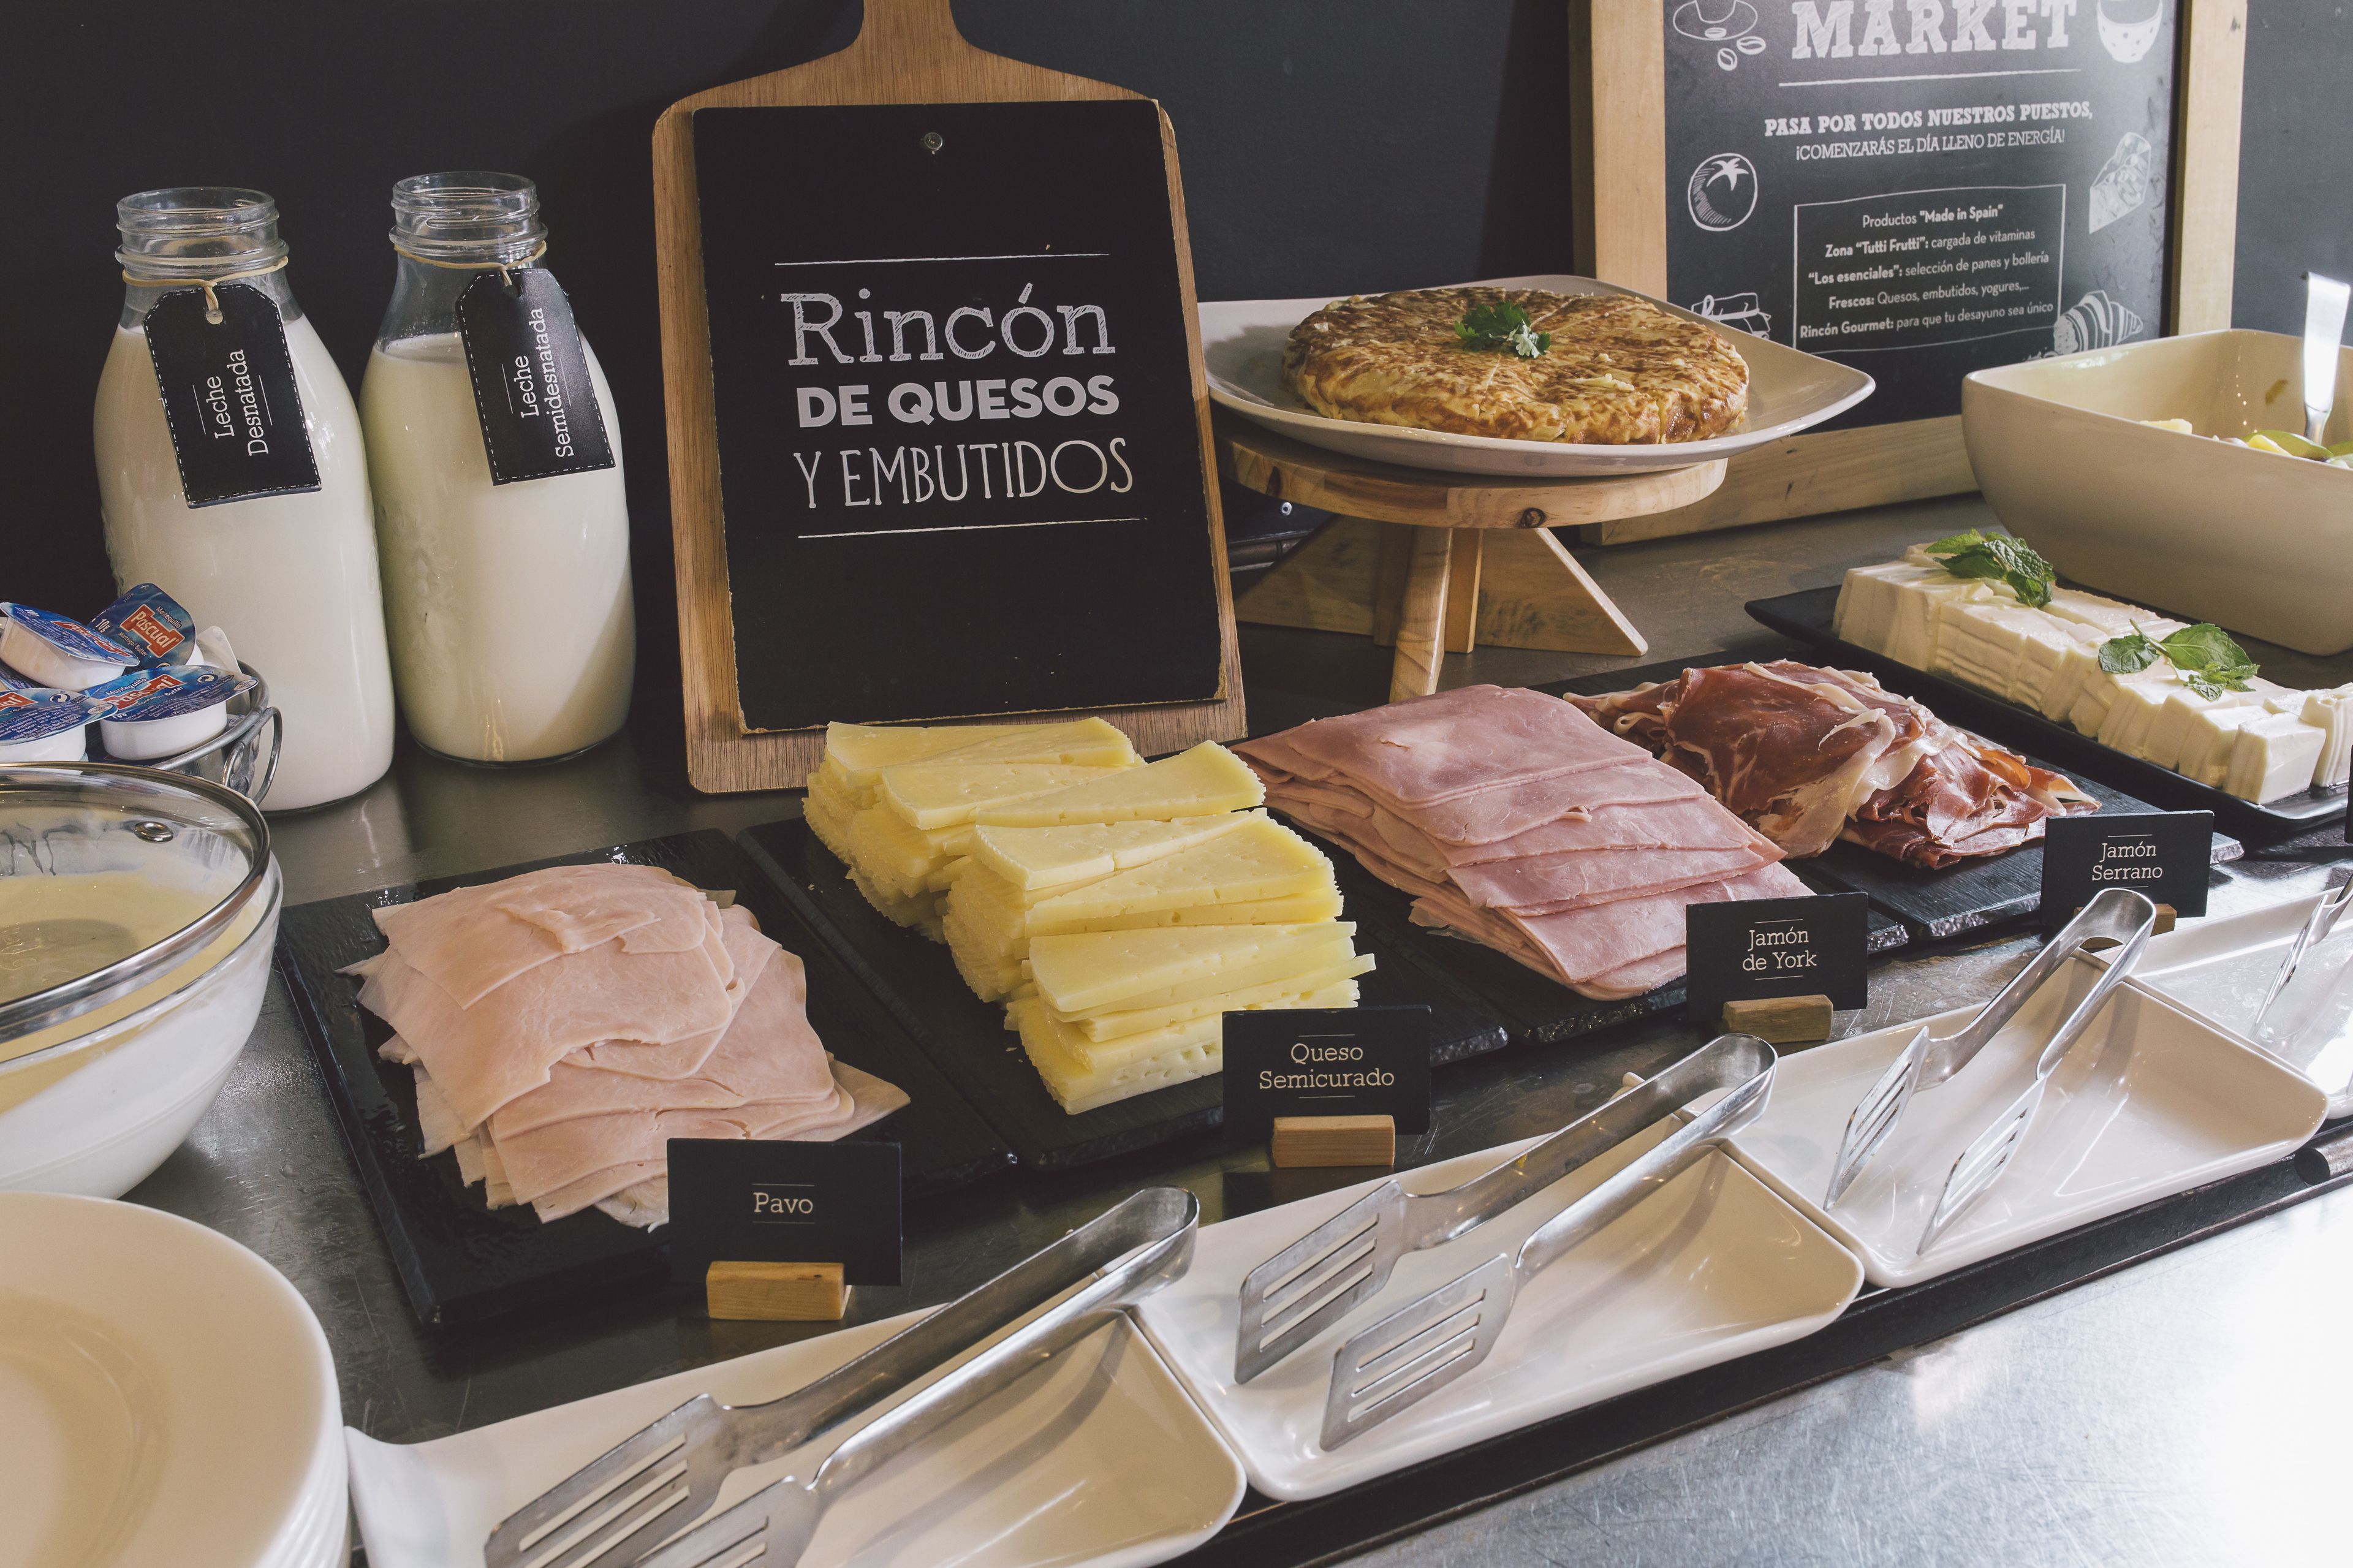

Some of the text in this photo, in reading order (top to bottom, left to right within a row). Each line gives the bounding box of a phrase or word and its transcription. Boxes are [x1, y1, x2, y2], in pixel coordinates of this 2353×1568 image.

[1792, 0, 2077, 59] MARKET
[1764, 100, 2094, 137] PASA POR TODOS NUESTROS PUESTOS,
[1796, 125, 2066, 161] ¡COMENZARÁS EL DÍA LLENO DE ENERGÍA!
[1862, 213, 1917, 228] Productos
[1957, 208, 1967, 220] in
[1825, 244, 1854, 258] Zona
[1931, 232, 1971, 251] cargada
[1973, 230, 1987, 244] de
[1989, 229, 2036, 243] vitaminas
[1905, 260, 1953, 276] selección
[1955, 258, 1969, 271] de
[1971, 259, 2002, 273] panes
[2004, 258, 2010, 270] y
[2012, 251, 2050, 266] bollería
[1828, 296, 1874, 309] Frescos:
[1877, 291, 1920, 305] Quesos,
[1922, 284, 1979, 300] embutidos,
[780, 282, 1116, 366] Rincón
[1800, 301, 2054, 339] Rincón Gourmet: para que tu desayuno sea único
[513, 355, 540, 419] Leche
[528, 307, 574, 458] Semidesnatada
[206, 376, 235, 439] Leche
[227, 349, 269, 456] Desnatada
[796, 374, 1120, 428] DE QUESOS
[793, 437, 1133, 509] Y EMBUTIDOS
[95, 618, 111, 634] 10g
[131, 610, 177, 648] Pascual
[156, 606, 183, 629] Mantequilla
[134, 644, 148, 657] Butter
[106, 677, 147, 696] Mantequilla
[164, 686, 184, 697] Butter
[2099, 841, 2157, 863] Jamón
[2092, 865, 2163, 881] Serrano
[1747, 926, 1809, 952] Jamón
[1742, 950, 1817, 971] de York
[1290, 1043, 1363, 1065] Queso
[1259, 1067, 1395, 1089] Semicurado
[753, 1192, 814, 1214] Pavo
